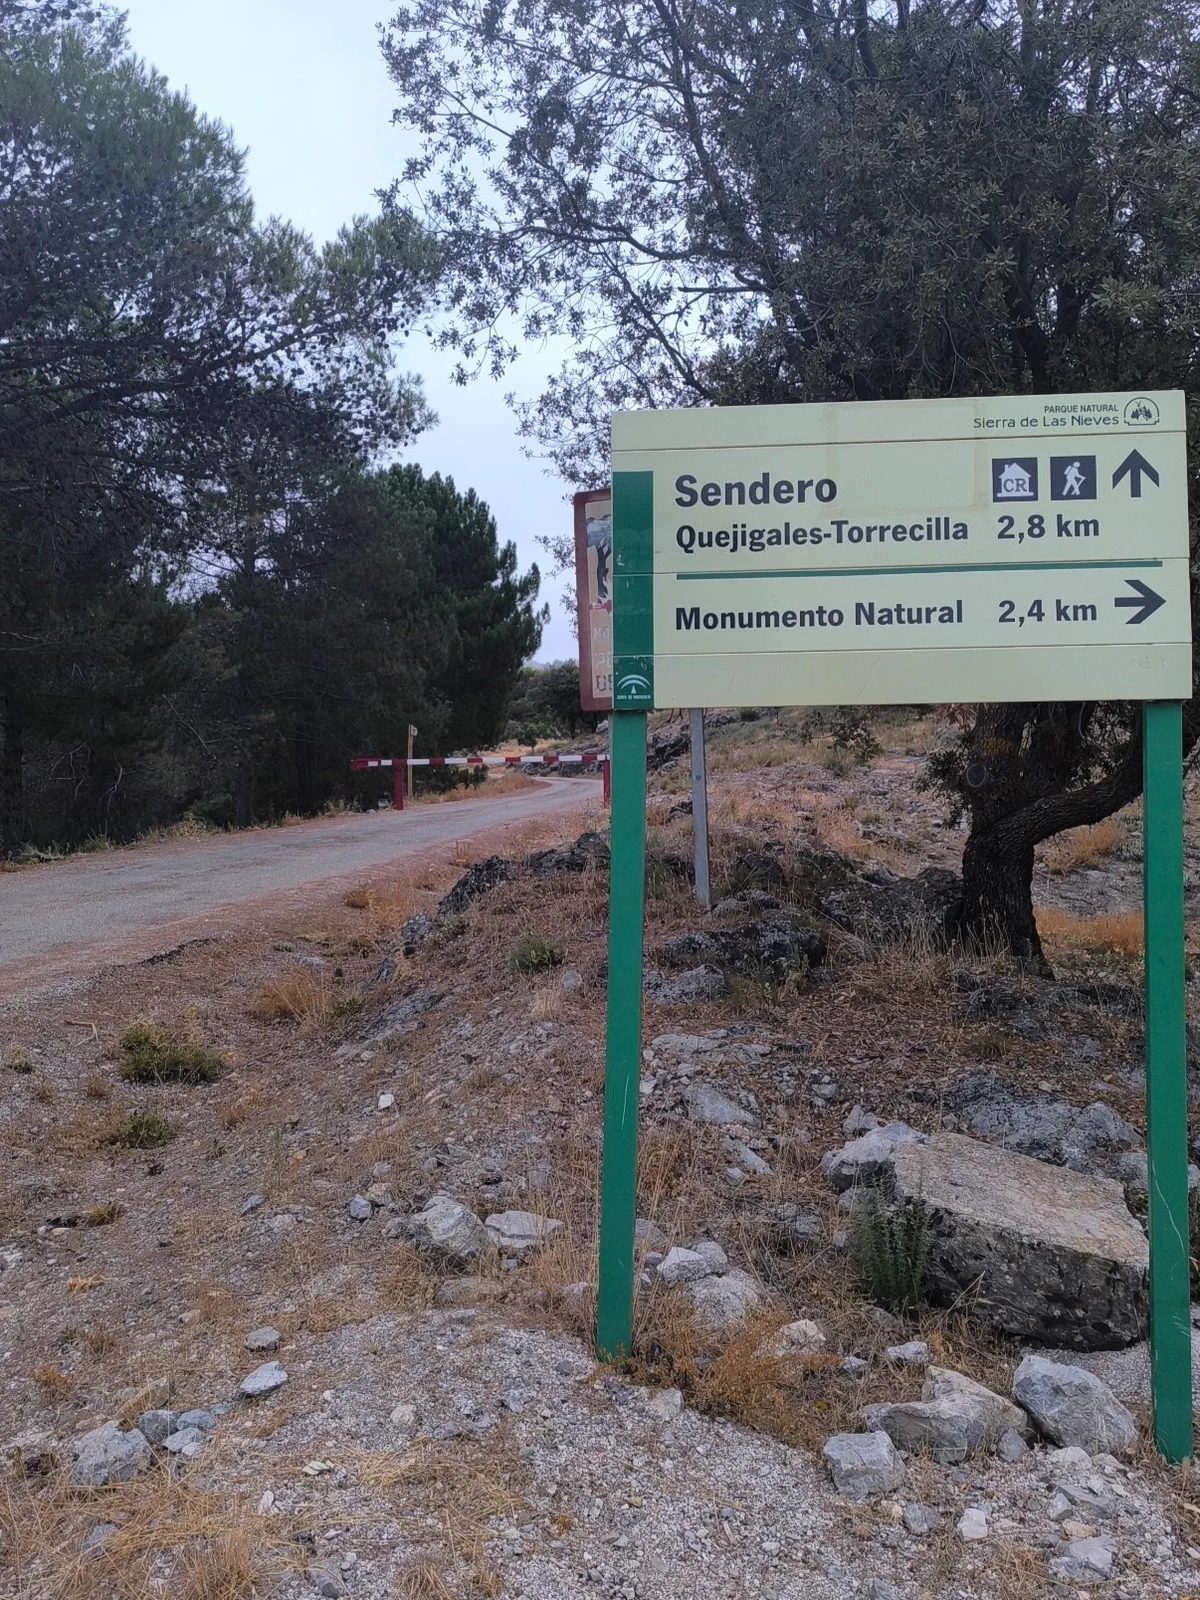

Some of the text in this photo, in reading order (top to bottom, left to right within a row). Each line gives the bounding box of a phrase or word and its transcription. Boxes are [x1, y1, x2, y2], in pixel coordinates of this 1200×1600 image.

[1044, 404, 1119, 413] PARQUE NATURAL
[973, 414, 1119, 428] Sierra de Las Nieves
[675, 472, 838, 507] Sendero
[1003, 478, 1028, 493] CR
[676, 513, 1100, 553] Quejigales-Torrecilla 2,8 km
[675, 598, 1097, 631] Monumento Natural 2,4 km
